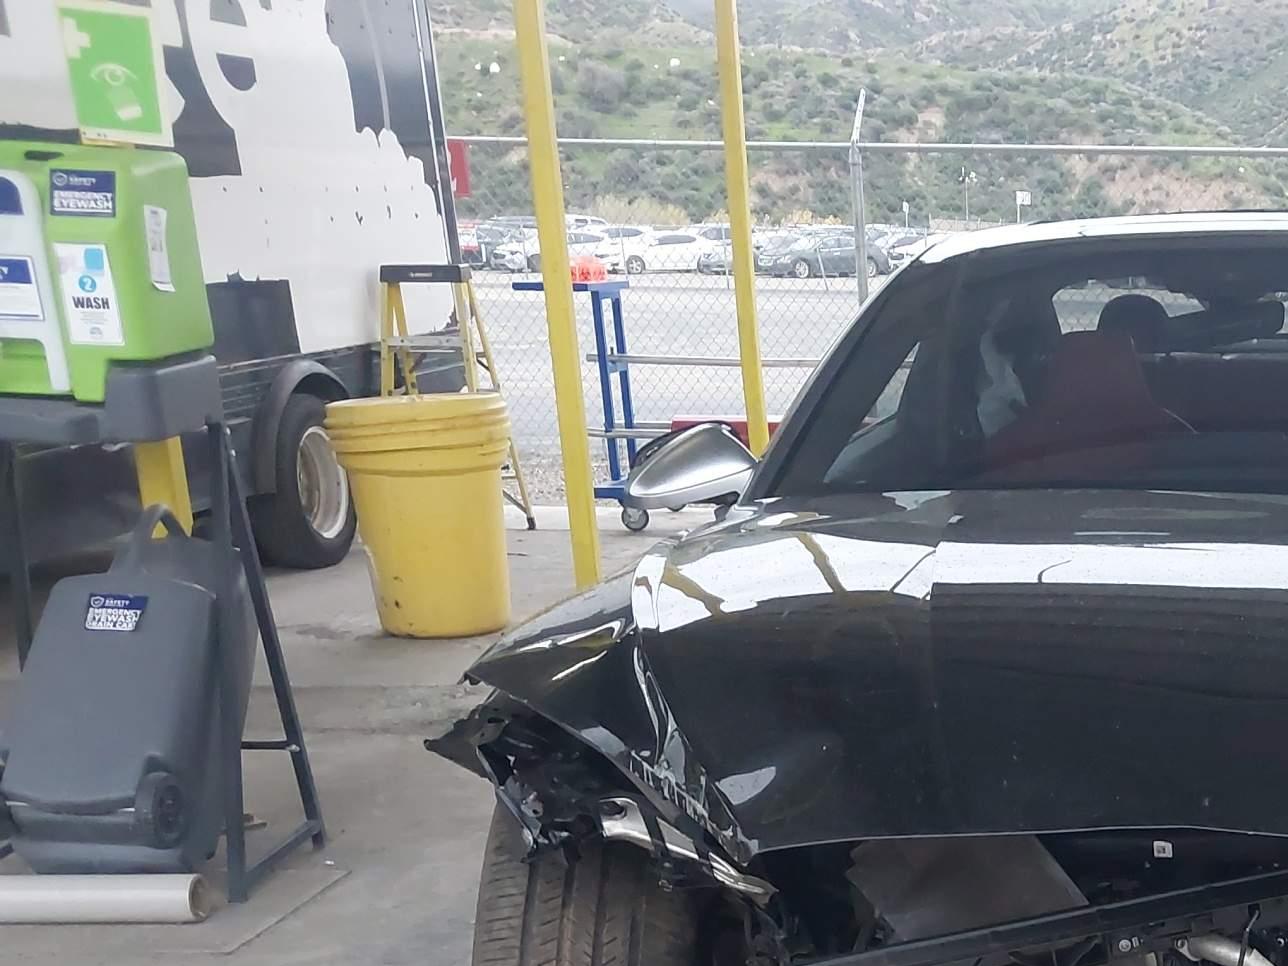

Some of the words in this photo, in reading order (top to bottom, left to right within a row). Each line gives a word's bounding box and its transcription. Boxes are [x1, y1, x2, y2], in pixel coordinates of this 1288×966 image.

[53, 190, 113, 200] EMERGENCY
[53, 199, 113, 209] EYEWASH
[82, 276, 94, 291] 2
[72, 296, 110, 310] WASH
[87, 613, 140, 623] EYEWASH
